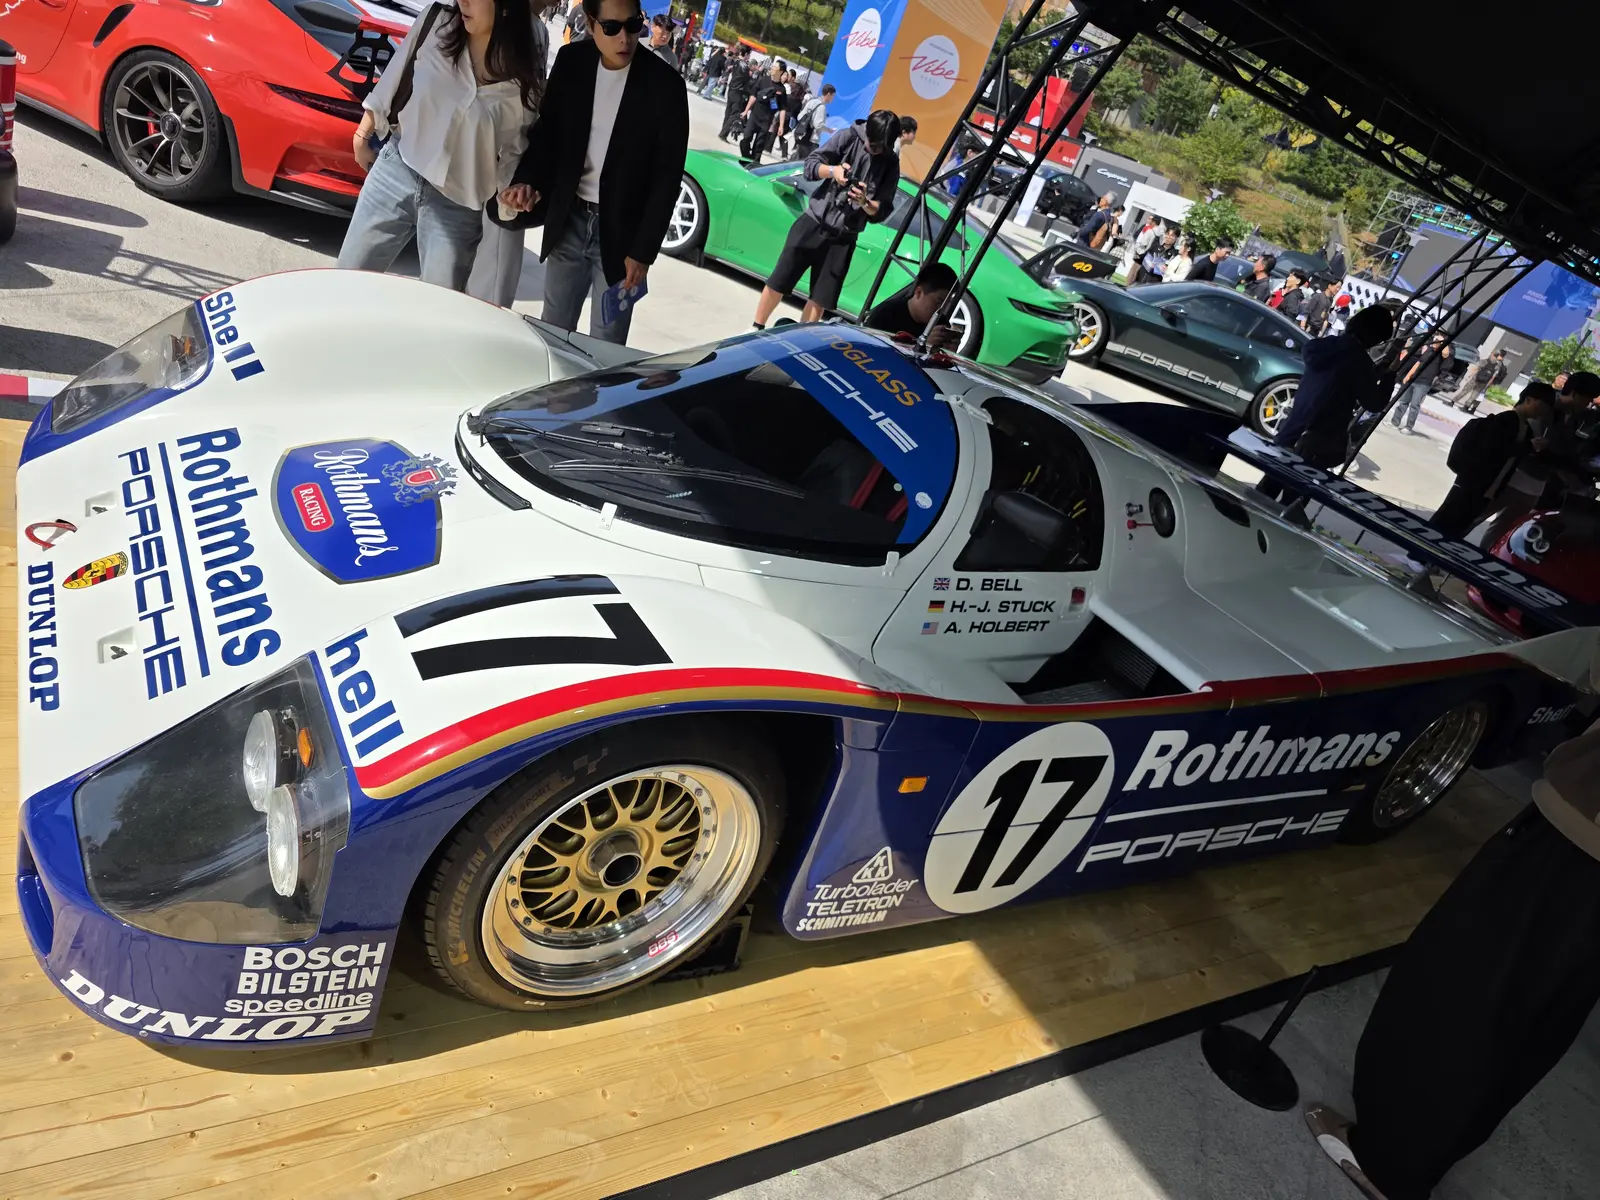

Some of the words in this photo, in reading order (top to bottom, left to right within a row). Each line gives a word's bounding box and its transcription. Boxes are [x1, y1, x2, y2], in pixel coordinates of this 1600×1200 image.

[841, 30, 885, 49] Vibe
[899, 55, 969, 83] Vibe
[205, 291, 265, 381] Shell
[756, 332, 919, 453] ORSCHE
[1123, 347, 1239, 395] PORSCHE
[299, 487, 326, 526] RACING
[313, 448, 399, 567] Rothmans
[118, 447, 187, 700] PORSCHE
[177, 427, 282, 667] Rothmans
[956, 578, 973, 591] D.
[980, 578, 1023, 591] BELL
[997, 600, 1056, 613] STUCK
[27, 562, 60, 712] DUNLOP
[394, 573, 674, 681] 17
[944, 621, 962, 634] A.
[968, 620, 1050, 634] HOLBERT
[325, 627, 404, 760] hell
[1123, 725, 1401, 794] Rothmans
[954, 755, 1108, 894] 17
[1076, 808, 1350, 873] PORSCHE
[448, 847, 487, 938] MICHELIN
[806, 894, 904, 916] TELETRON
[814, 878, 919, 900] Turbolader
[243, 942, 387, 970] BOSCH
[650, 931, 678, 956] BBS
[60, 969, 371, 1041] DUNLOP
[224, 990, 374, 1016] speedline
[236, 965, 380, 995] BILSTEIN
